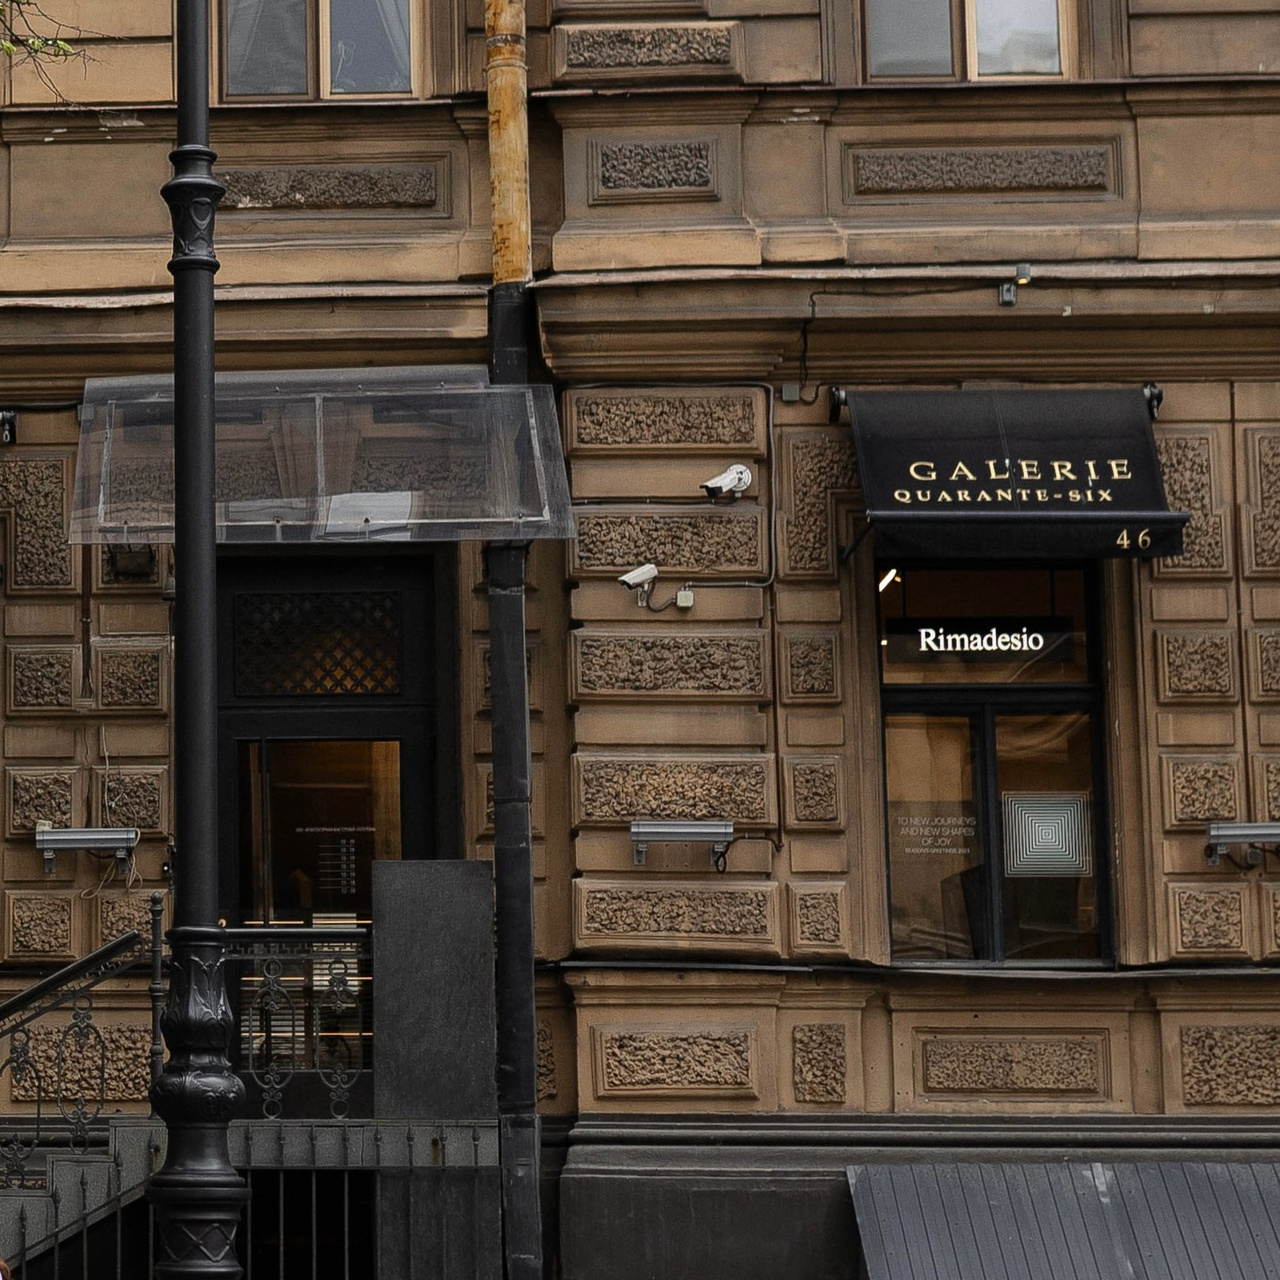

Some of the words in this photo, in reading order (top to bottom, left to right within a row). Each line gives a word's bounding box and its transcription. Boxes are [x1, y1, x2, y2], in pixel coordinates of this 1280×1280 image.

[908, 458, 1132, 482] GALERIE
[893, 488, 1113, 503] QUARANTE-SIX
[1116, 528, 1152, 549] 46
[918, 626, 1045, 652] Rimadesio
[909, 816, 930, 825] NEW
[931, 816, 977, 826] JOURNEYS
[919, 826, 941, 836] NEW
[941, 826, 975, 836] SHAPES
[934, 836, 952, 847] JOY
